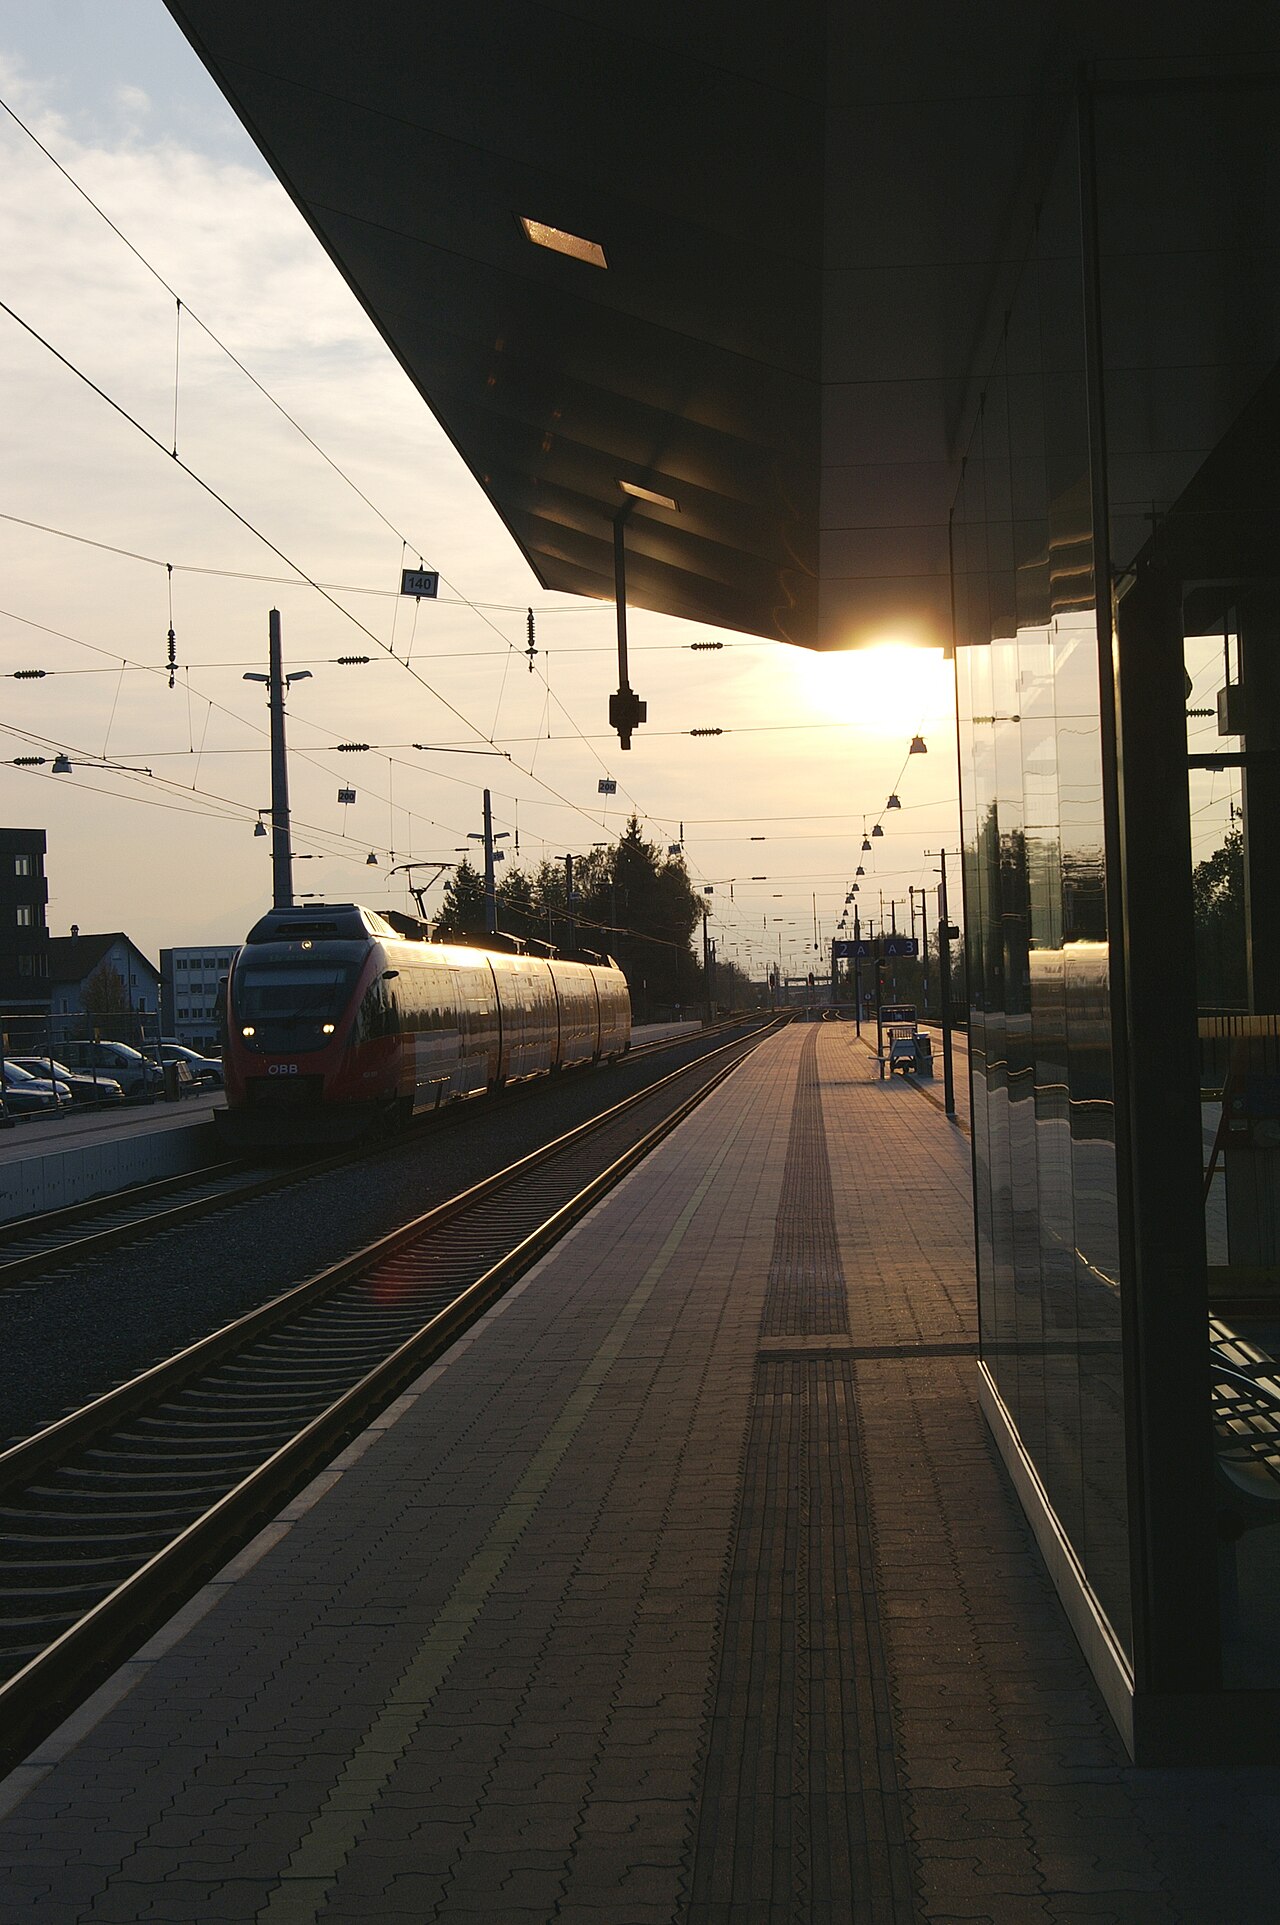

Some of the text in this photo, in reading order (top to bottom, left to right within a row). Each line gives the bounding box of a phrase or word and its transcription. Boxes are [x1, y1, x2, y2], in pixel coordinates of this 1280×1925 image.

[408, 577, 431, 590] 140
[600, 783, 616, 791] 200
[340, 792, 355, 801] 200
[839, 944, 866, 956] 2 A
[888, 941, 914, 954] A 3
